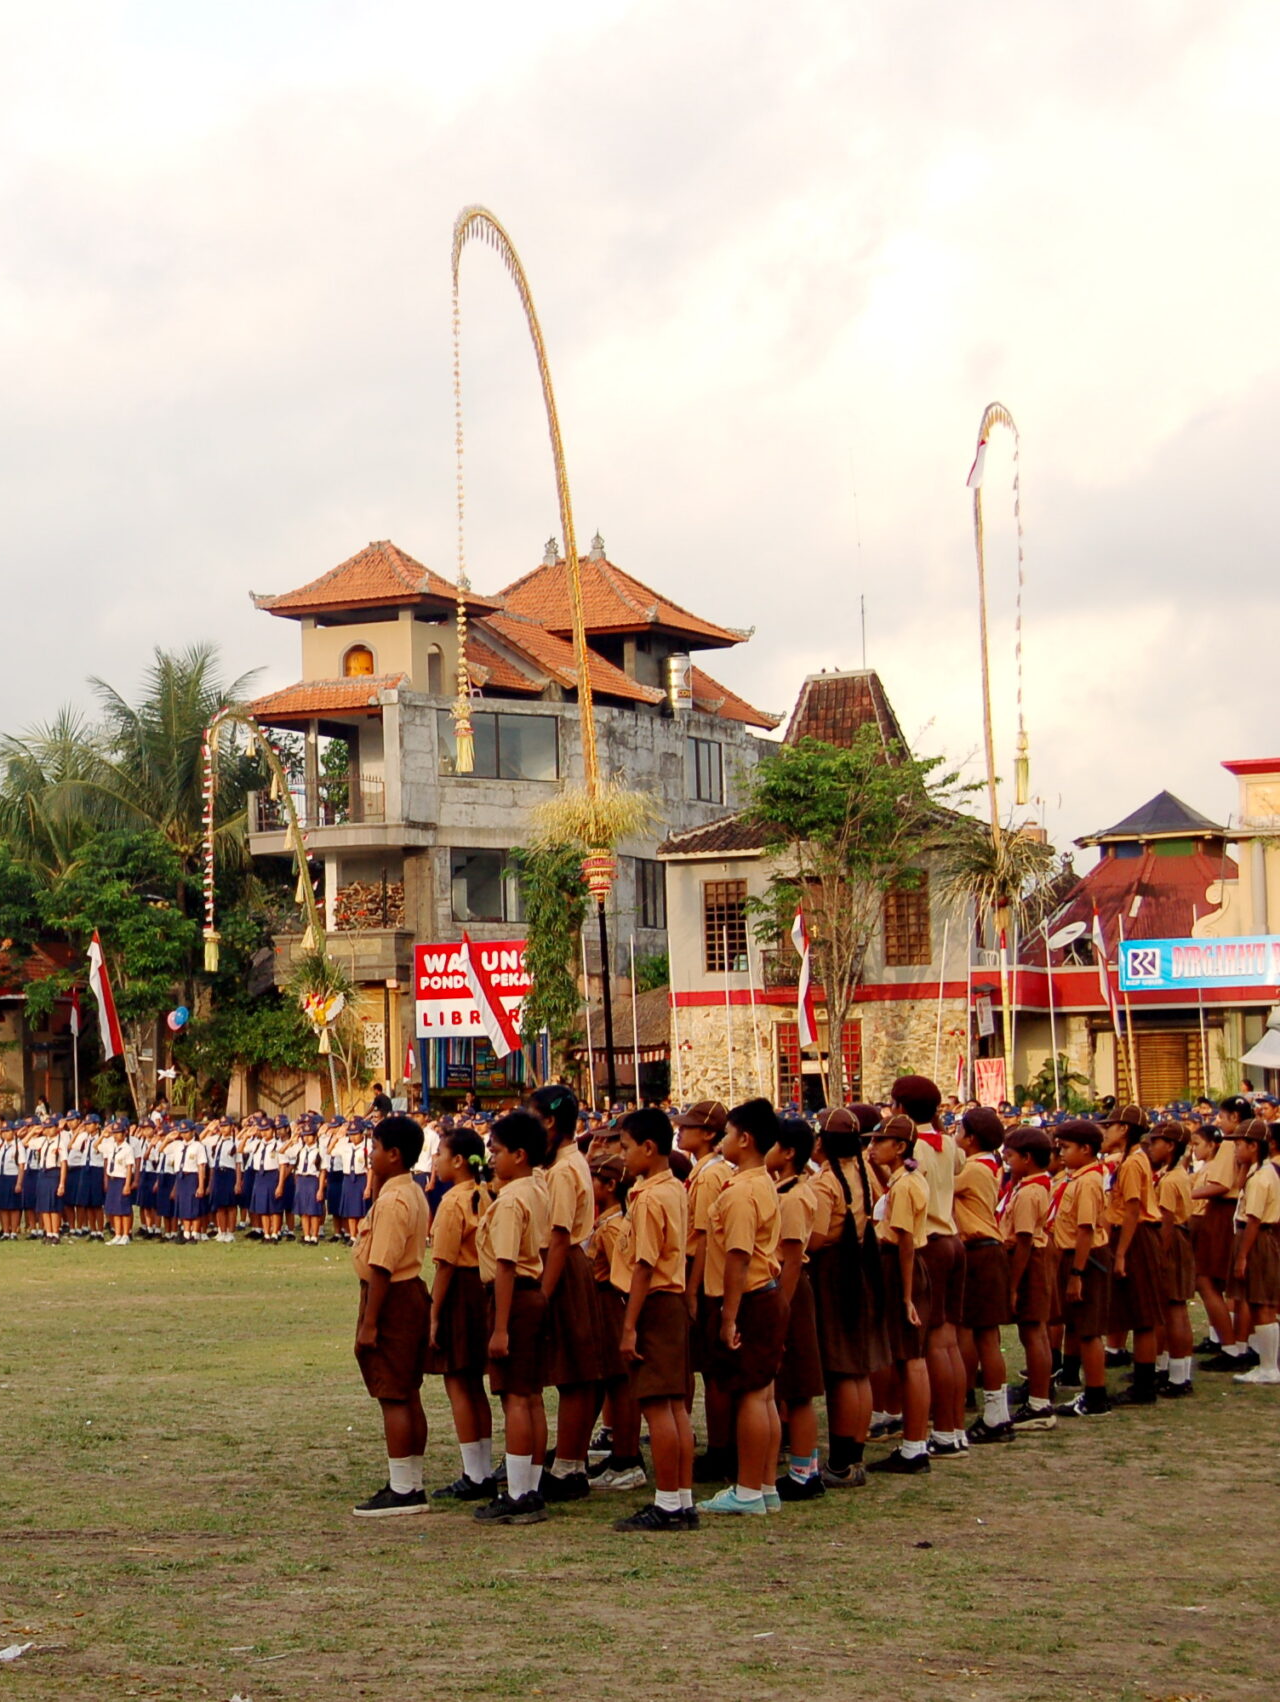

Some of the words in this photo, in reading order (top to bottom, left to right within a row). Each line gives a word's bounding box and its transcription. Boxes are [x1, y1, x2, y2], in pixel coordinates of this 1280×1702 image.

[423, 950, 526, 974] WAUN
[420, 976, 471, 990] POND
[491, 973, 534, 987] PEKA
[423, 1010, 521, 1026] LIBRR
